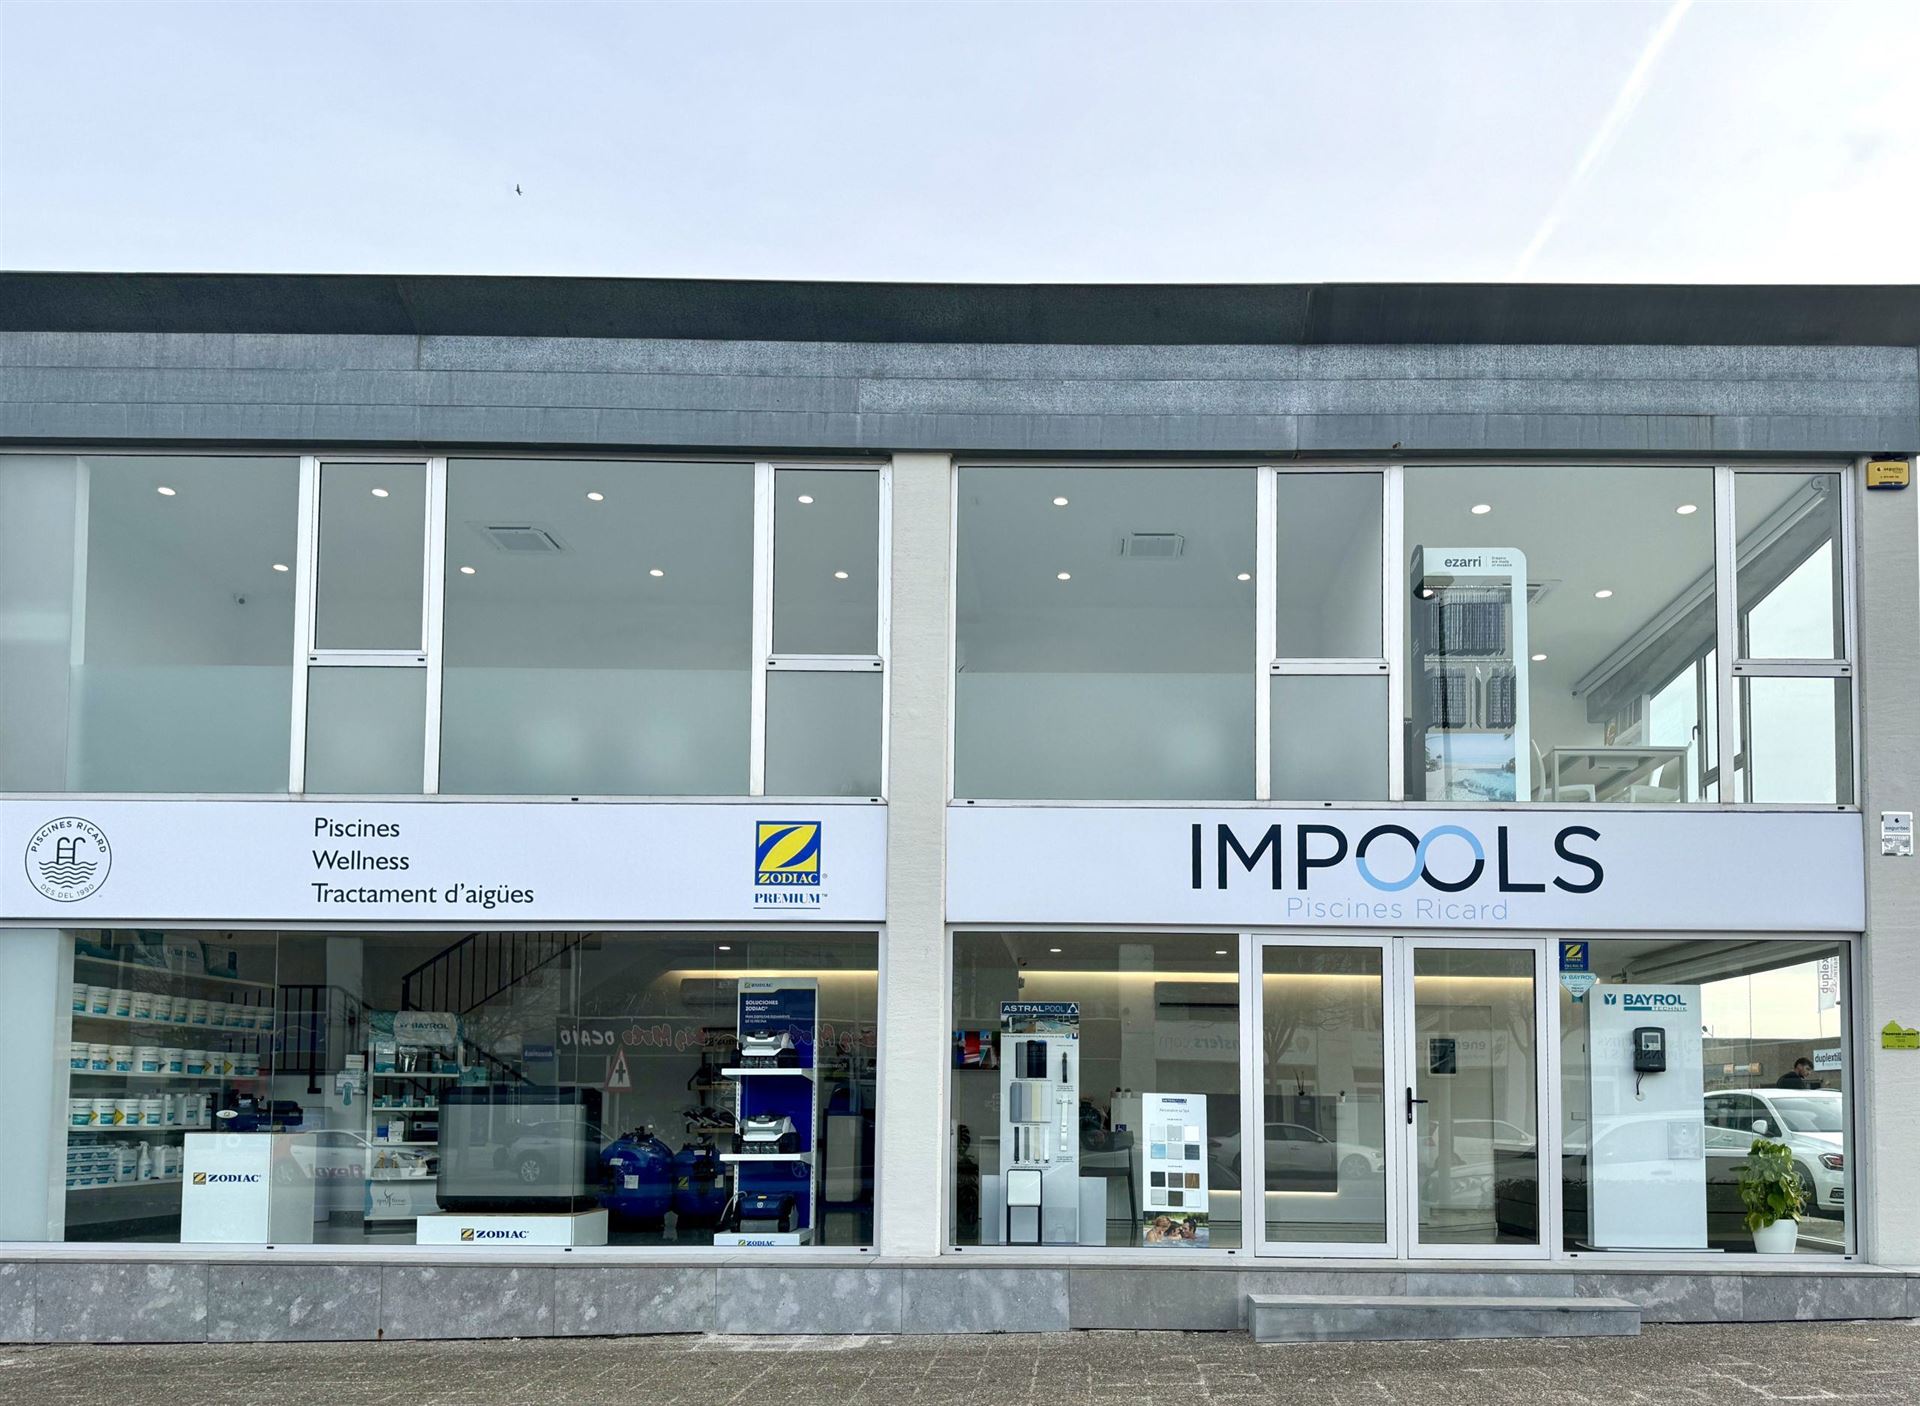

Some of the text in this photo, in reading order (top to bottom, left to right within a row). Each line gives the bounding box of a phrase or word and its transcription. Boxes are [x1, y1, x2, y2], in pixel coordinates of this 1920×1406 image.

[1444, 556, 1482, 568] ezarri
[314, 817, 400, 837] Piscines
[31, 820, 107, 853] PISCINES RICARD
[312, 850, 410, 870] Wellness
[1192, 824, 1604, 894] IMPOOLS
[758, 873, 818, 884] ZODIAC
[40, 883, 95, 899] DES DEL 1990
[311, 882, 437, 903] Tractament
[1287, 898, 1508, 921] Piscines Ricard
[1623, 993, 1688, 1006] BAYROL
[208, 1174, 260, 1183] ZODIAC
[476, 1230, 527, 1239] ZODIAC
